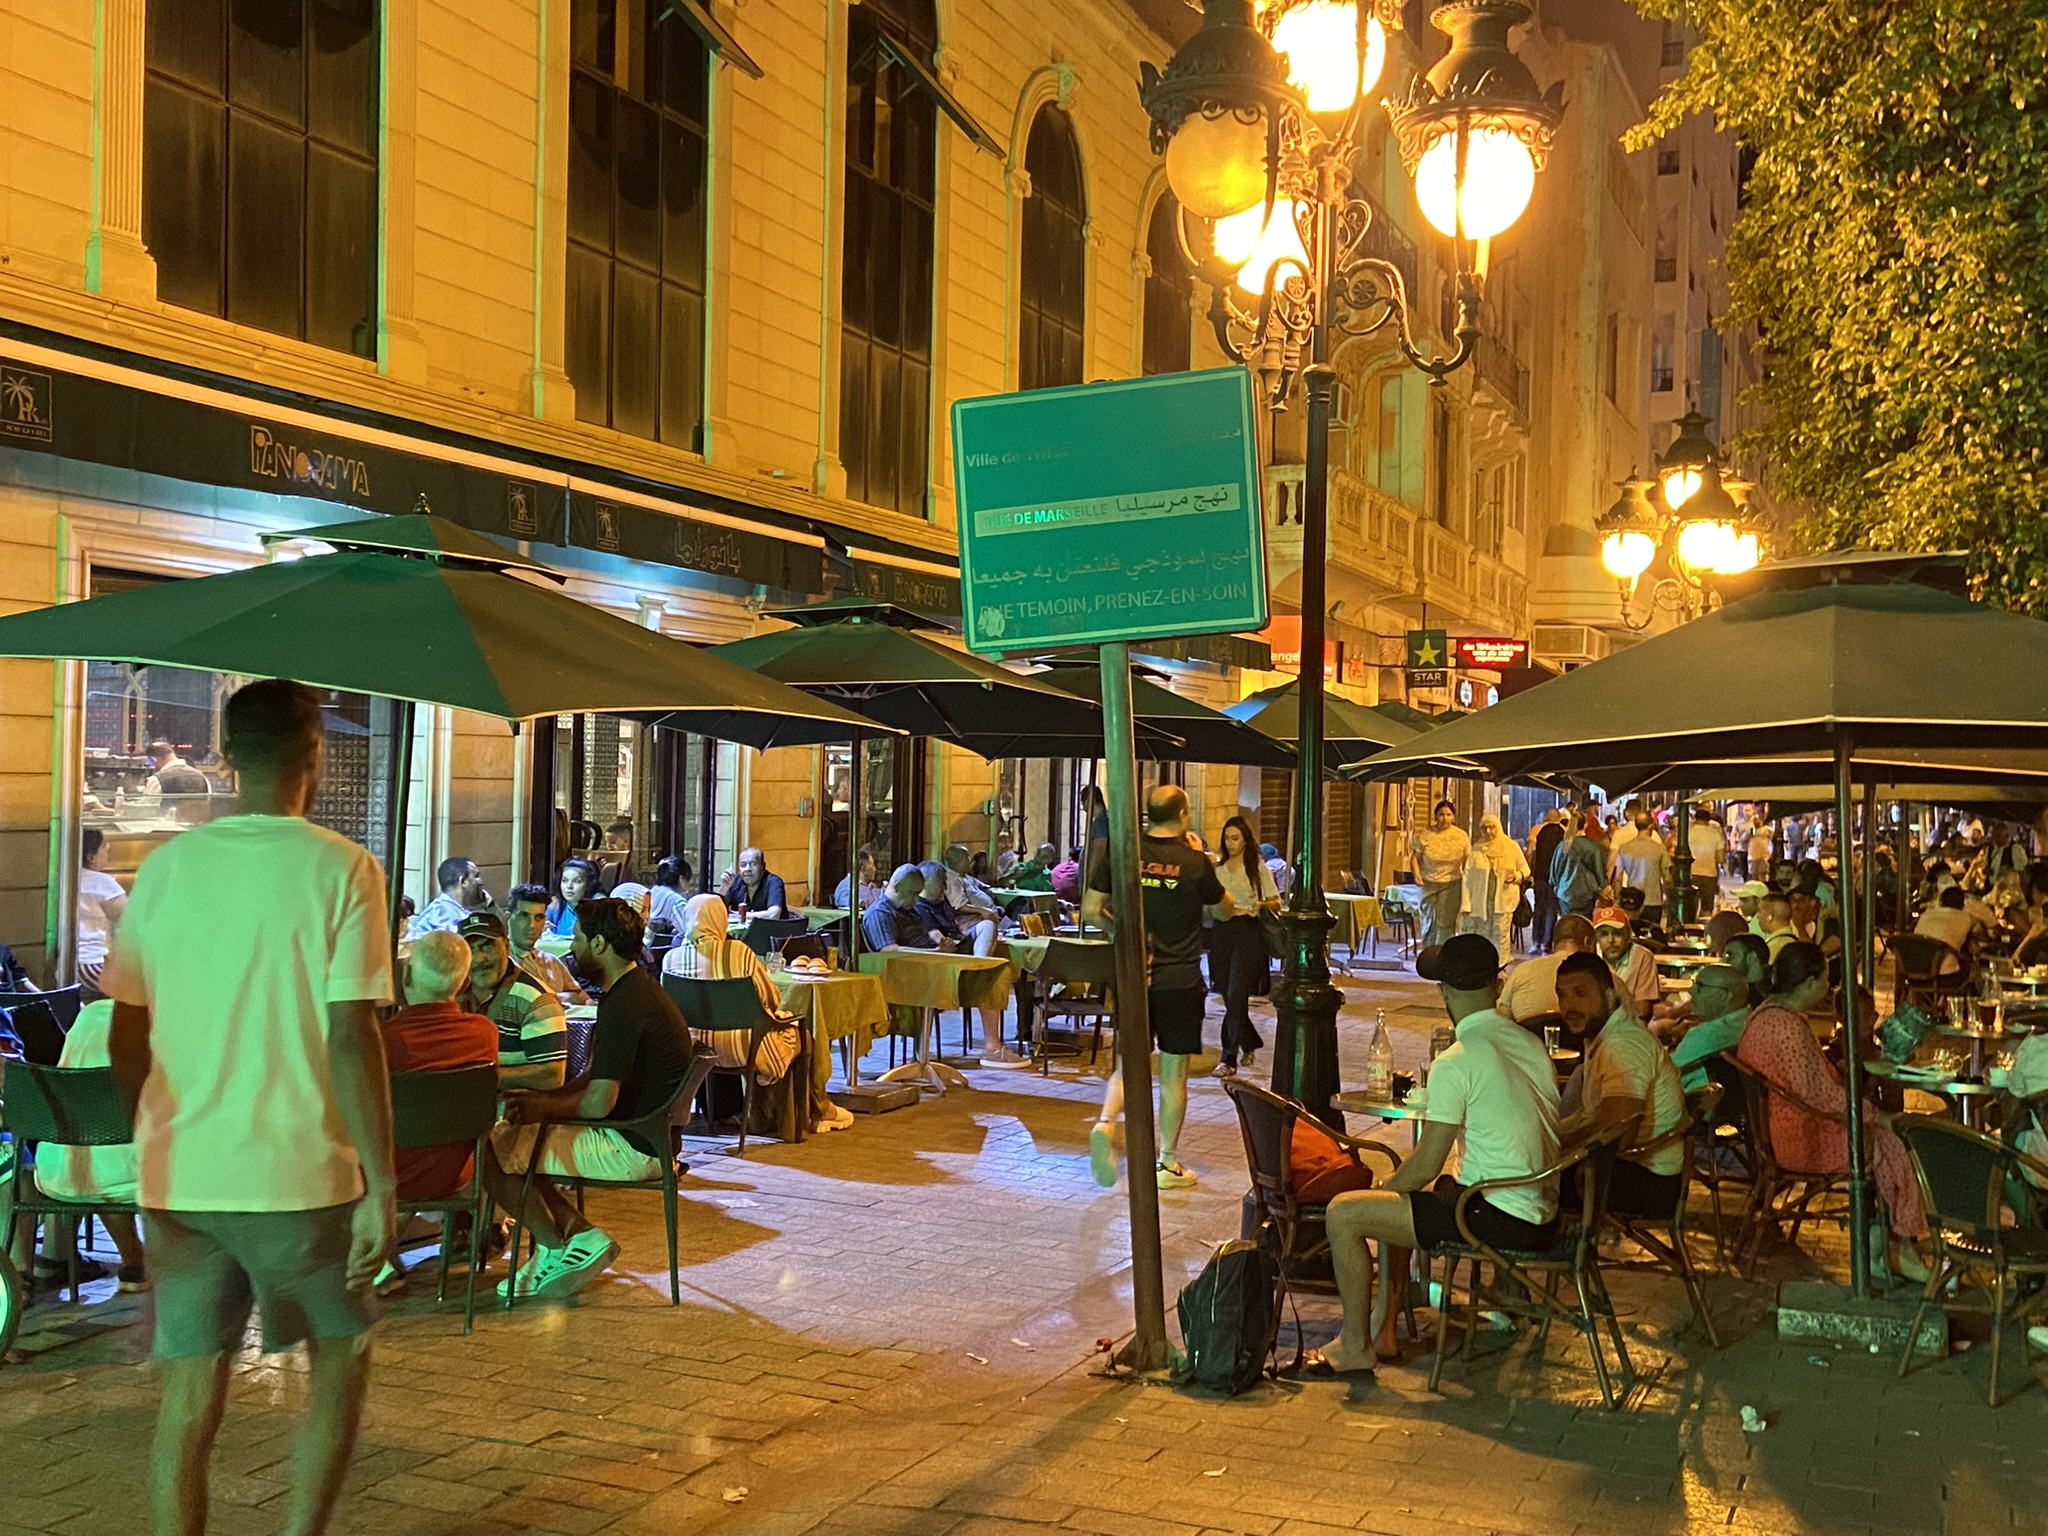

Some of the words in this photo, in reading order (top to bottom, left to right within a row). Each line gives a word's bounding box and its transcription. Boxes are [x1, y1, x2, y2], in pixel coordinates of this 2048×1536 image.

[965, 453, 998, 467] Ville
[1115, 496, 1189, 517] مرسيليا
[1193, 486, 1229, 512] نهج
[1014, 512, 1032, 525] DE
[1034, 503, 1109, 524] MARSEILLE
[1016, 596, 1092, 618] TEMOIN,
[1271, 652, 1300, 664] ange
[1414, 672, 1442, 681] STAR
